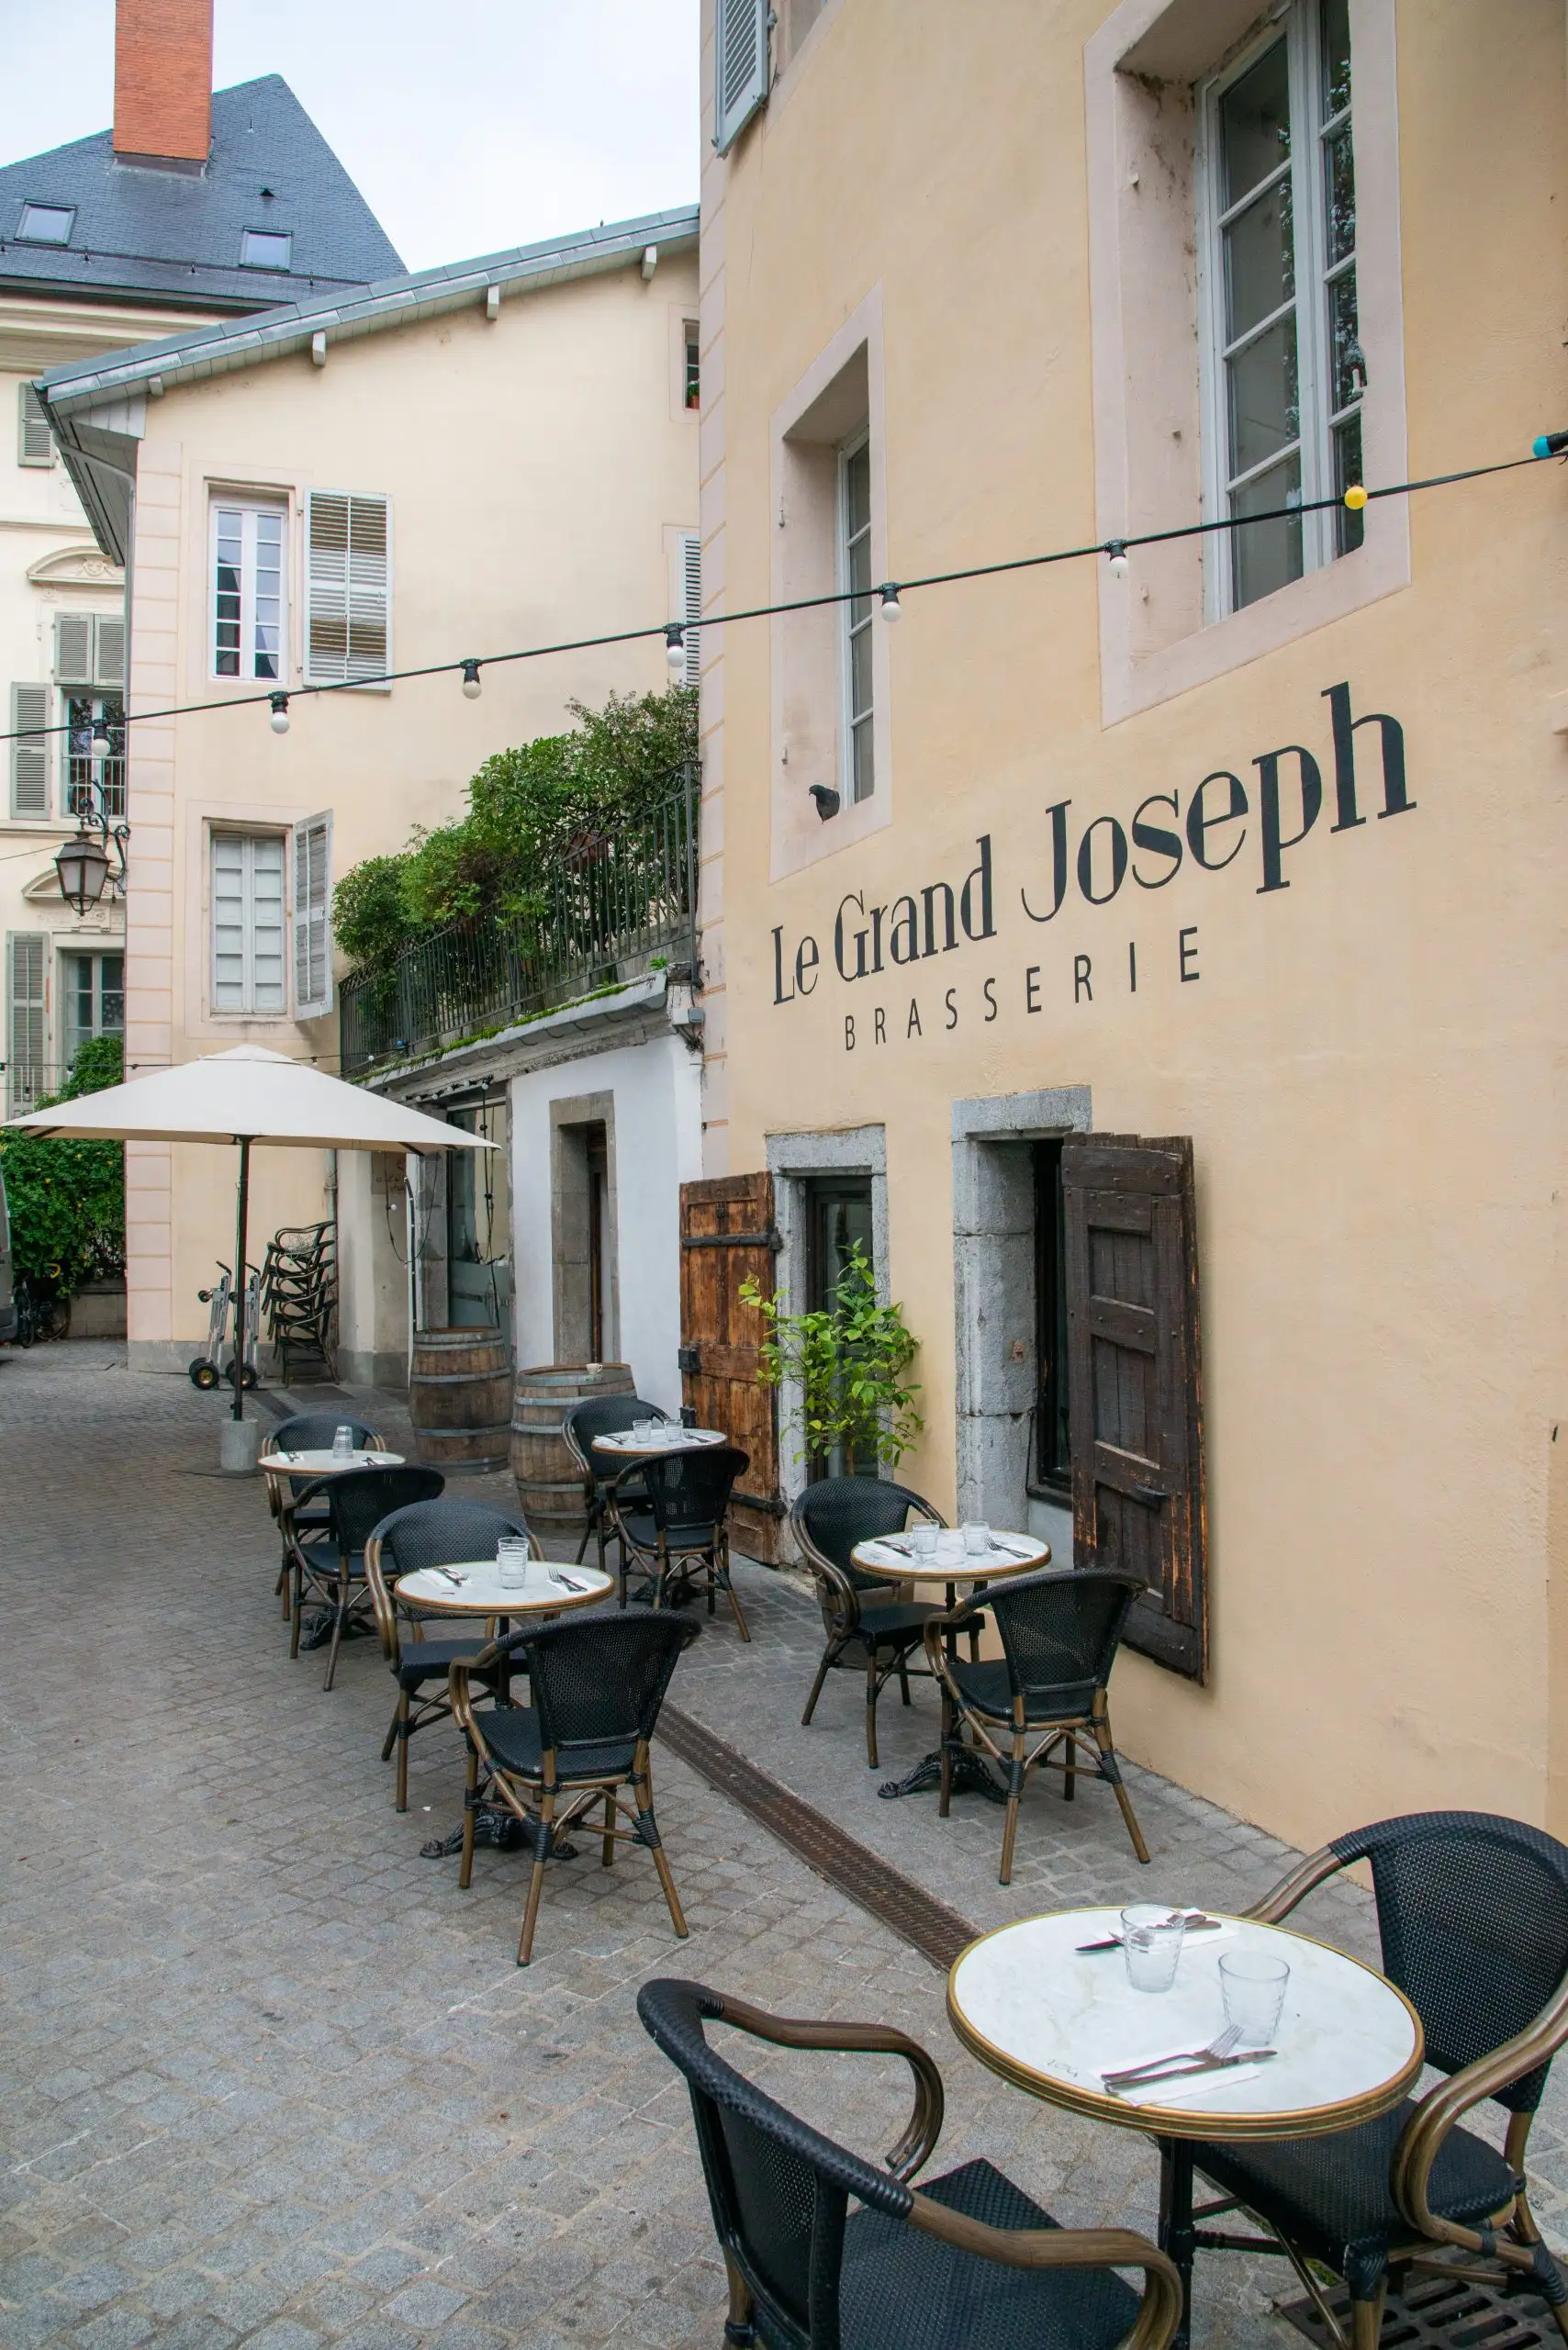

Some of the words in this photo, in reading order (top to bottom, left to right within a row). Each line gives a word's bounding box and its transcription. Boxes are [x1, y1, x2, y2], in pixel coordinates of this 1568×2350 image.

[771, 924, 820, 1006] Le
[834, 834, 998, 982] Grand
[1021, 680, 1417, 923] Joseph
[845, 926, 1200, 1051] BRASSERIE
